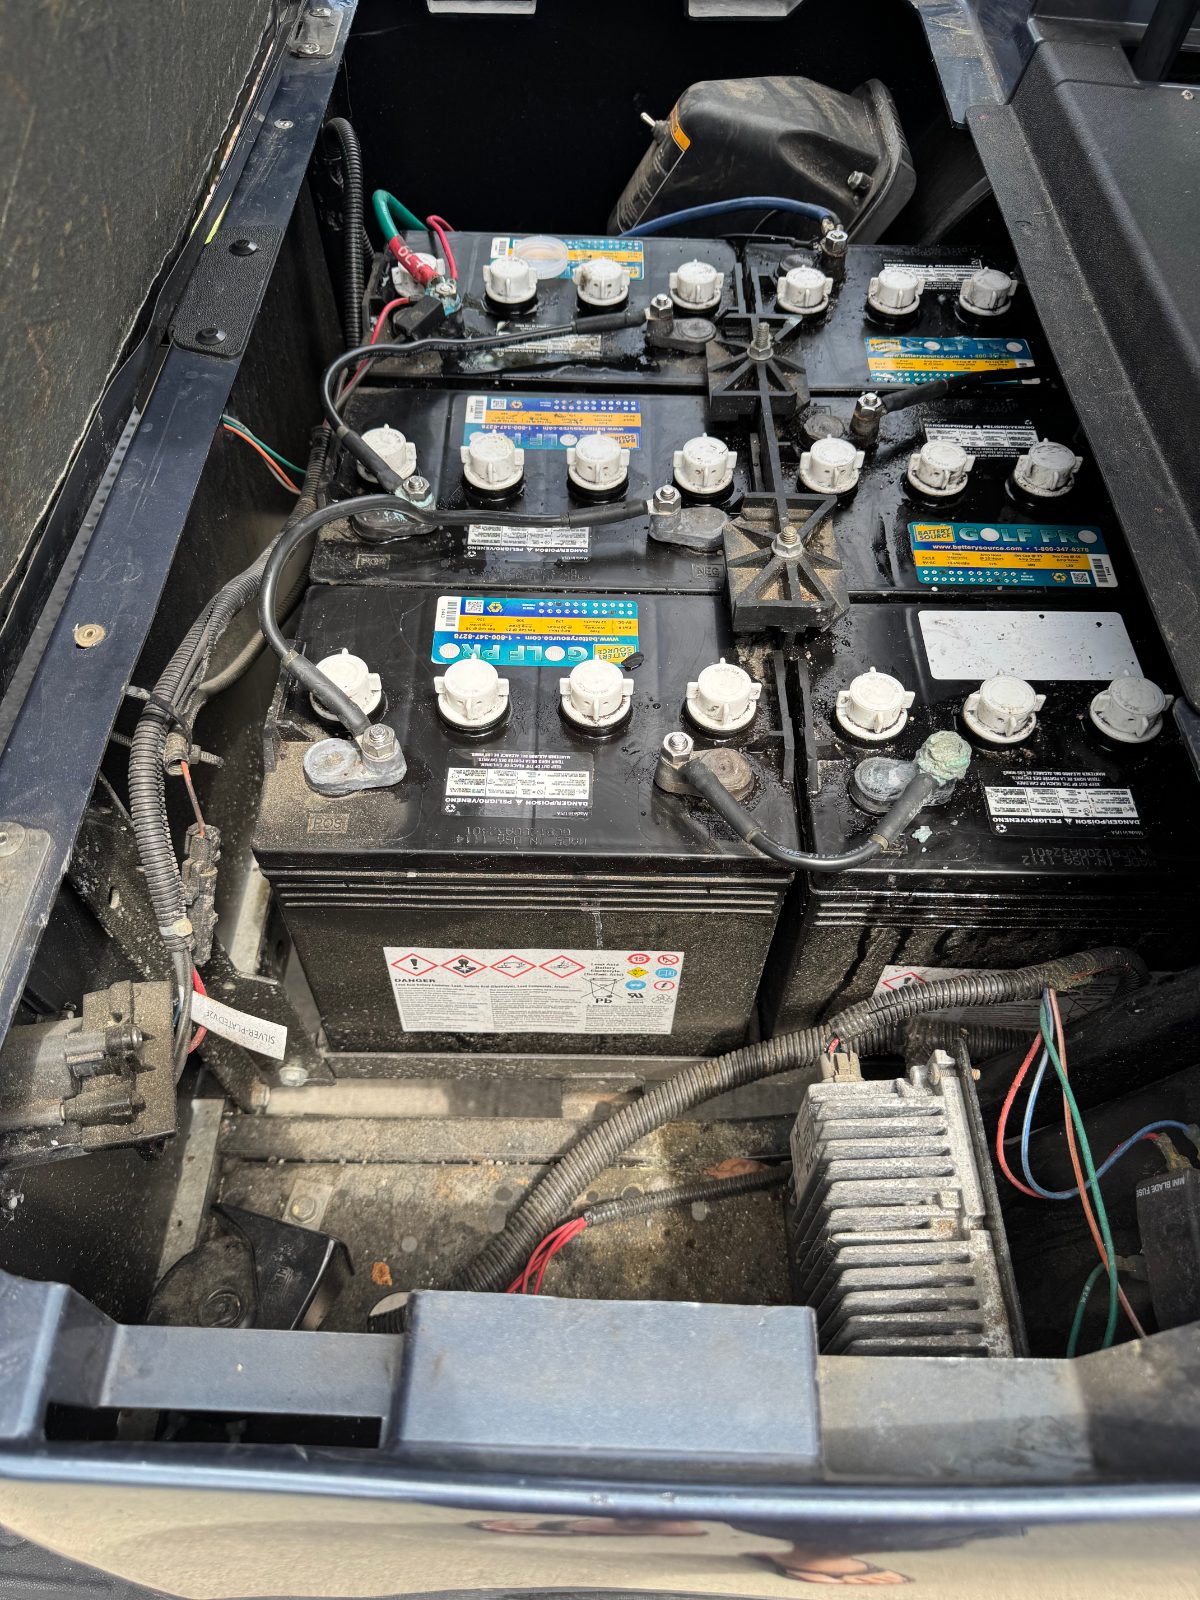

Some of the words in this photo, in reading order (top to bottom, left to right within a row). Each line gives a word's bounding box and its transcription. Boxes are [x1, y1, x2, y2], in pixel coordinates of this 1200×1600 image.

[530, 433, 578, 446] OLF
[918, 528, 951, 536] BATTERY
[959, 527, 1033, 542] GOLF
[1040, 529, 1099, 544] PRO
[698, 567, 720, 576] NEG
[439, 643, 500, 660] PRO
[509, 645, 588, 662] GOLF
[598, 646, 631, 655] SOURCE
[314, 818, 342, 829] POS
[1136, 1187, 1150, 1198] FUSE
[1151, 1181, 1171, 1193] BLADE
